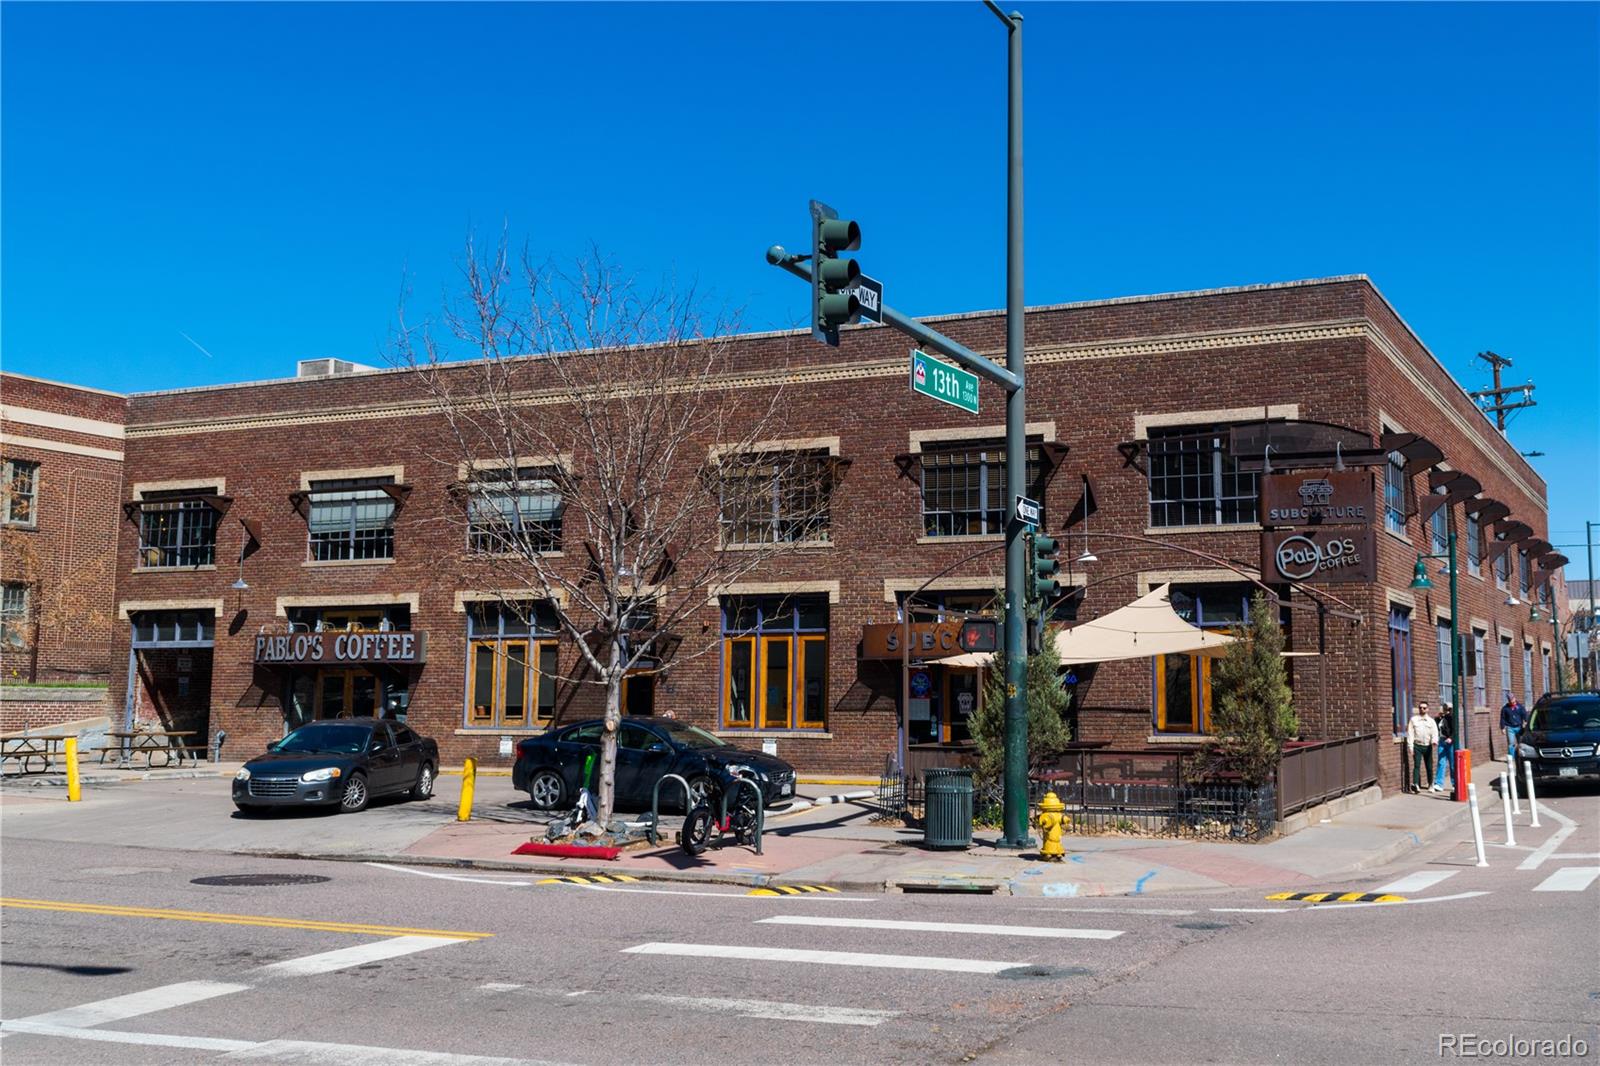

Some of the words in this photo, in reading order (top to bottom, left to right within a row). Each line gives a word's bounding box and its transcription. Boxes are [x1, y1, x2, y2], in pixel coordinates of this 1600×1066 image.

[859, 288, 876, 308] WAY
[932, 367, 960, 399] 13th
[965, 380, 974, 393] Ave
[962, 391, 973, 405] 1300
[1269, 505, 1365, 520] SUBCULTURE
[1319, 553, 1362, 571] COFFEE
[255, 635, 324, 661] PABLO'S
[335, 634, 415, 660] COFFEE
